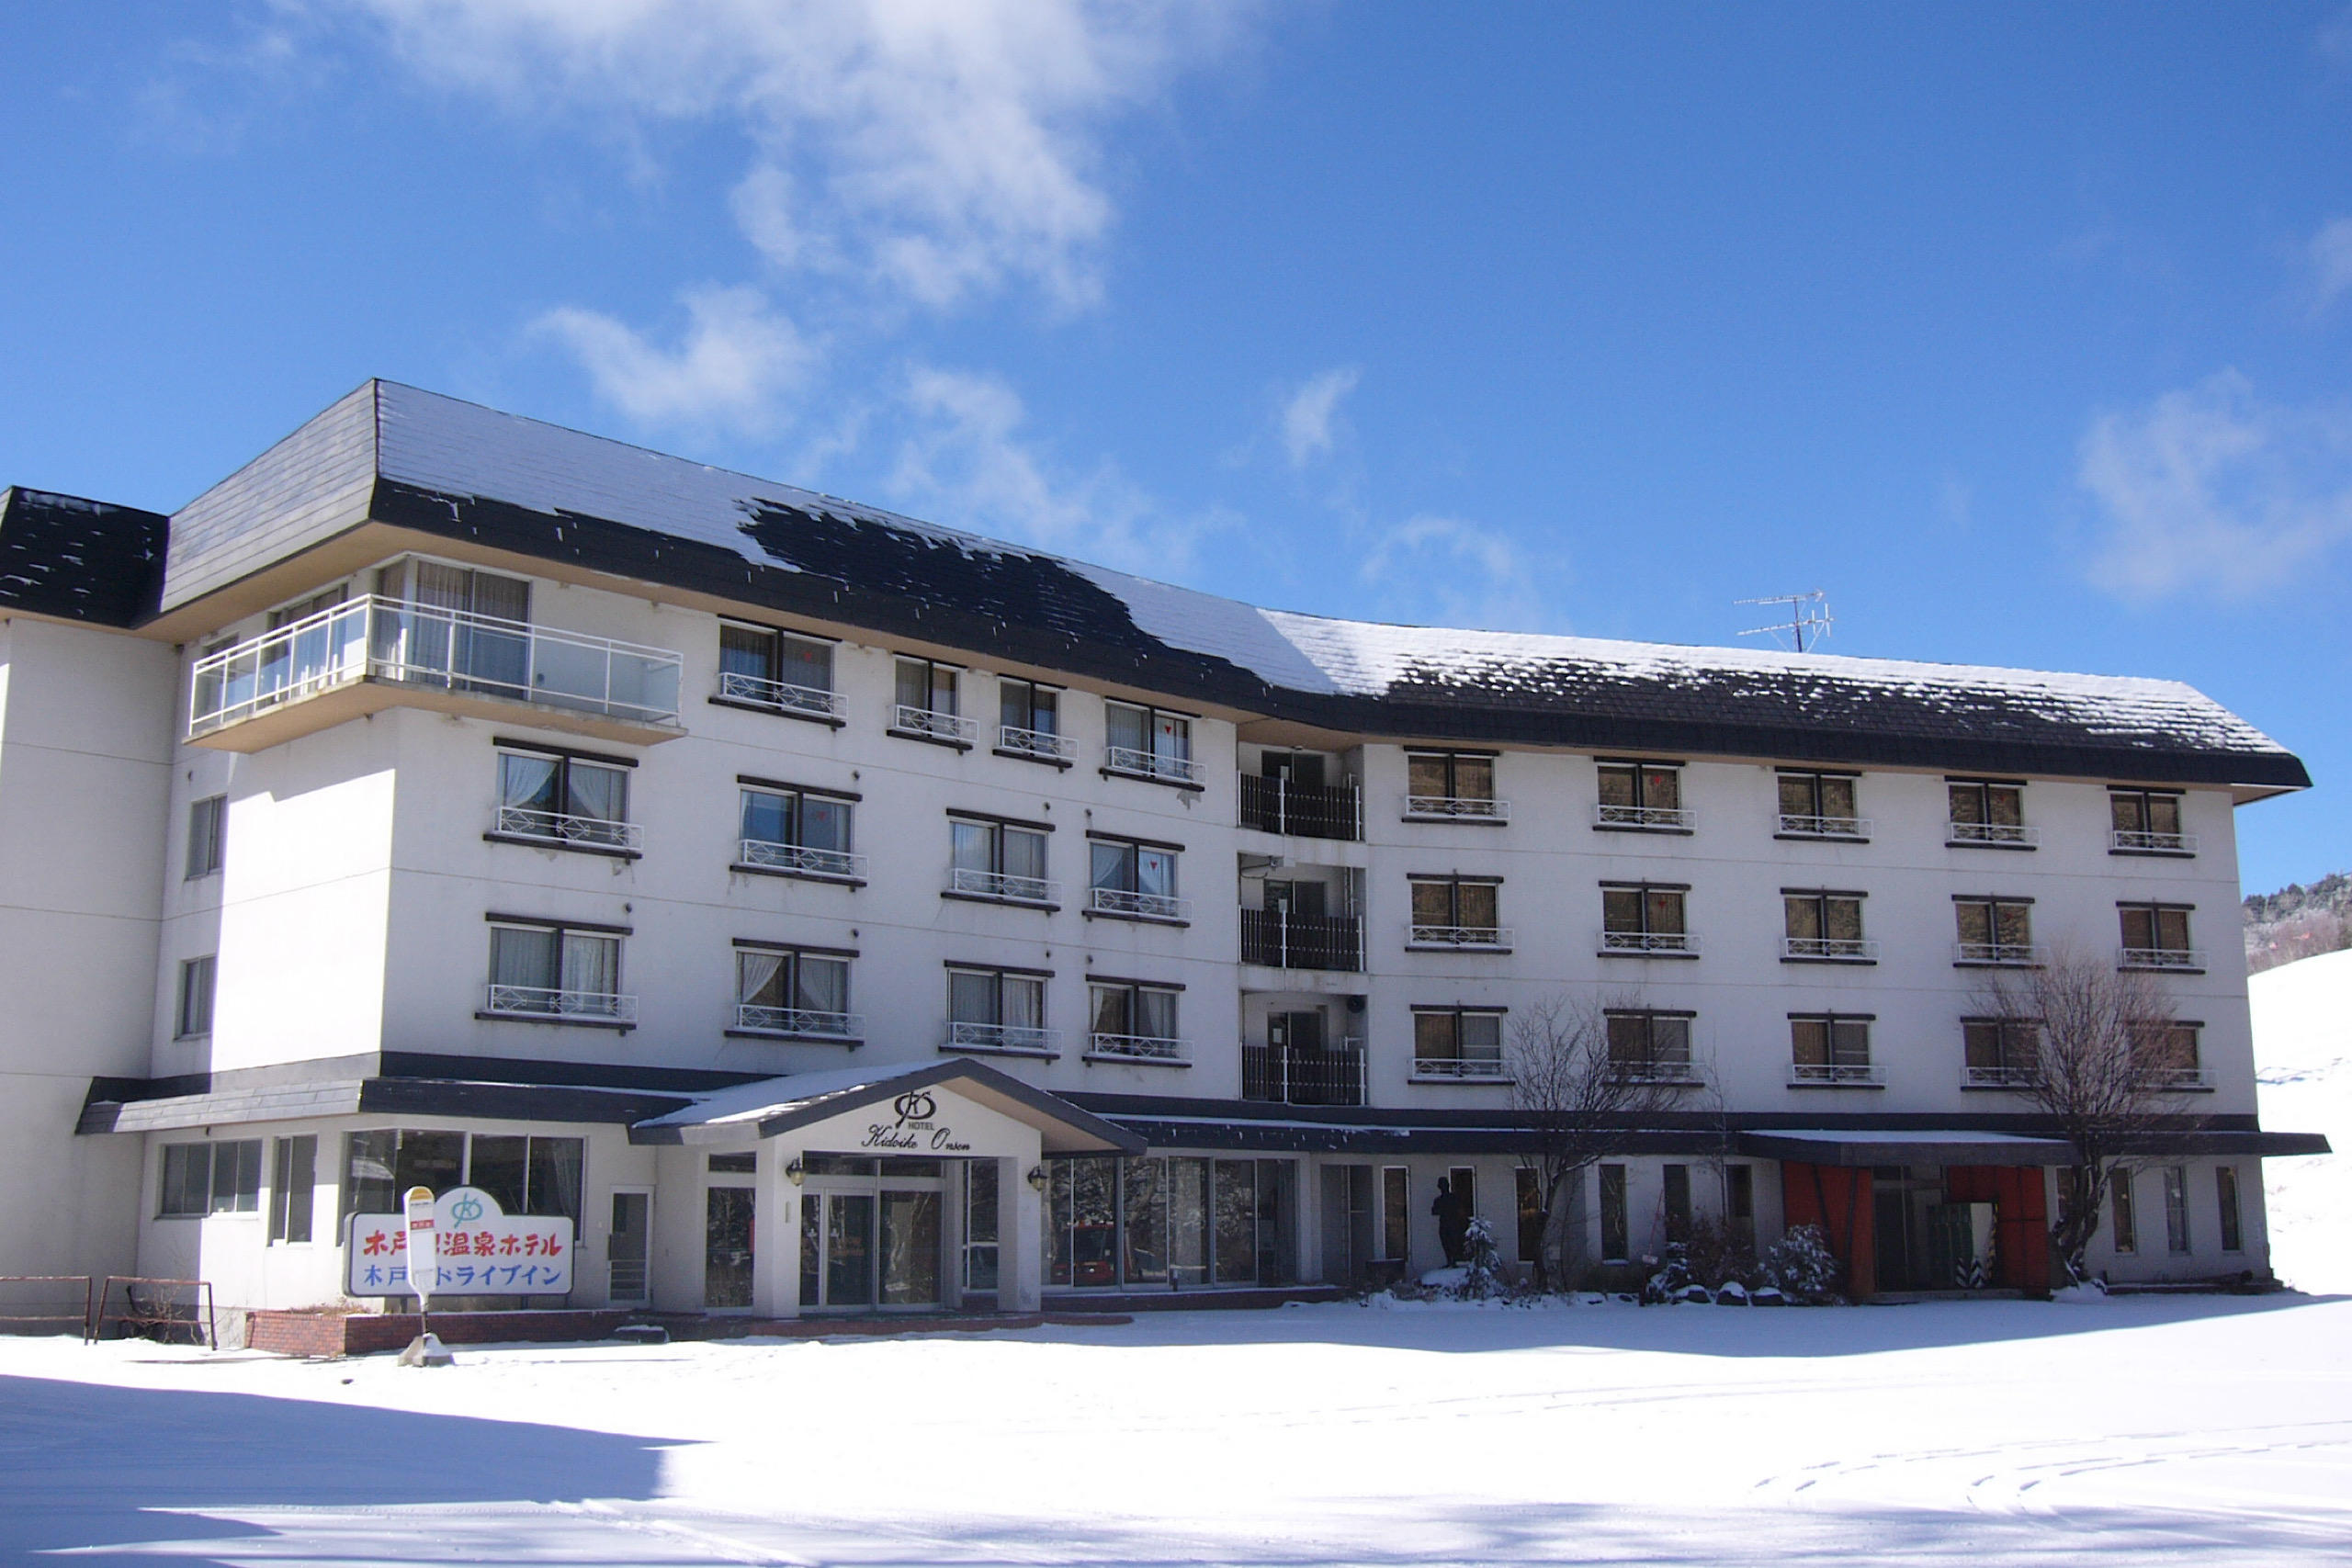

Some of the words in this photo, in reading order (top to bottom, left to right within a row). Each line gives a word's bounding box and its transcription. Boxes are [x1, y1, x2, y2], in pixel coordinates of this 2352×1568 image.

[861, 1123, 918, 1149] Kidoike
[931, 1127, 971, 1151] Onsen
[908, 1122, 935, 1131] HOTEL
[363, 1229, 563, 1258] 木戸温泉ホテル
[364, 1264, 561, 1287] 木戸ドライブイン
